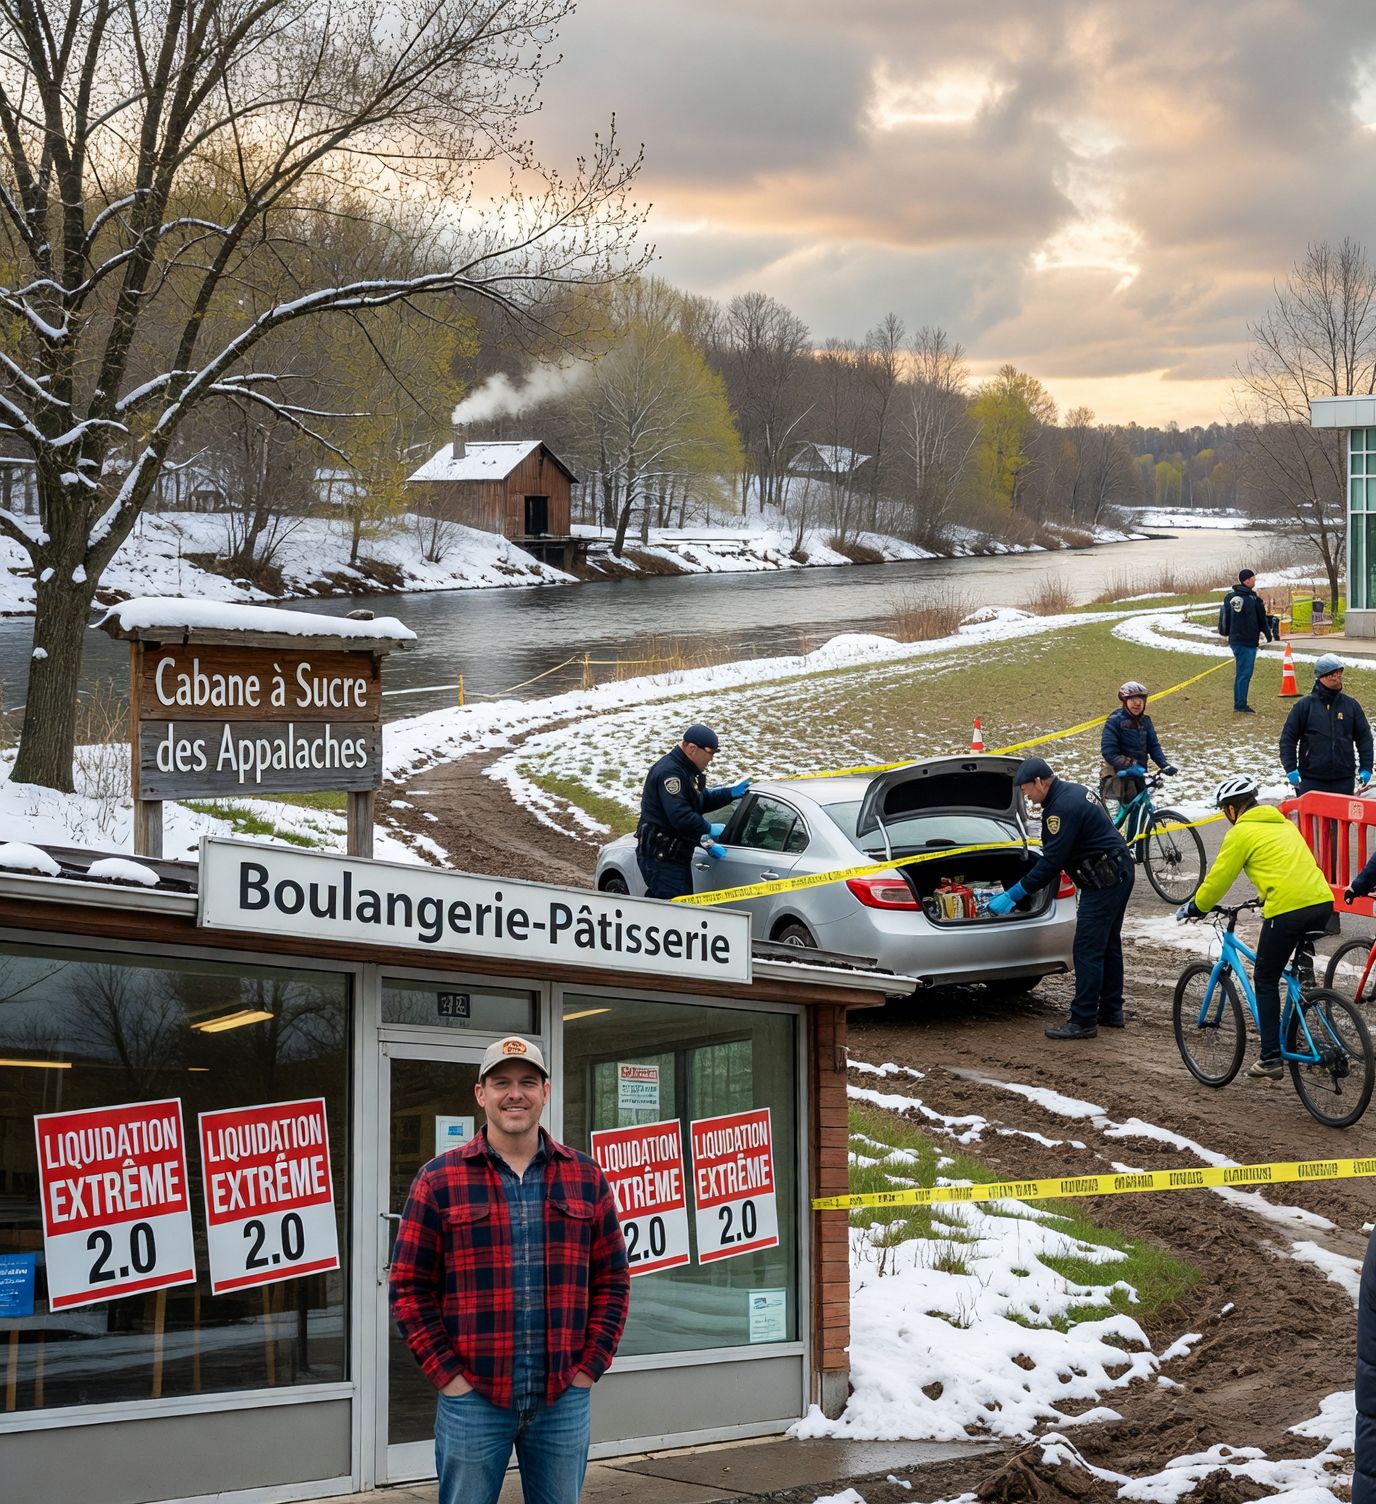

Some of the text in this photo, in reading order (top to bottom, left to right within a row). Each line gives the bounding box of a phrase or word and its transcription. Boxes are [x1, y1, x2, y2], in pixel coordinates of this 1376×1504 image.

[155, 657, 368, 708] Cabane à Sucre
[156, 723, 368, 783] des Appalaches
[239, 861, 730, 964] Boulangerie-Pâtisserie
[44, 1115, 178, 1170] LIQUIDATION
[207, 1113, 323, 1163] LIQUIDATION
[596, 1132, 679, 1173] LIQUIDATION
[695, 1121, 769, 1160] LIQUIDATION
[49, 1159, 182, 1224] EXTRÊME
[610, 1165, 681, 1213] XTRÊME
[243, 1212, 305, 1271] 2.0
[623, 1216, 666, 1264] 2.0
[718, 1199, 757, 1246] 2.0
[86, 1222, 157, 1285] 2.0
